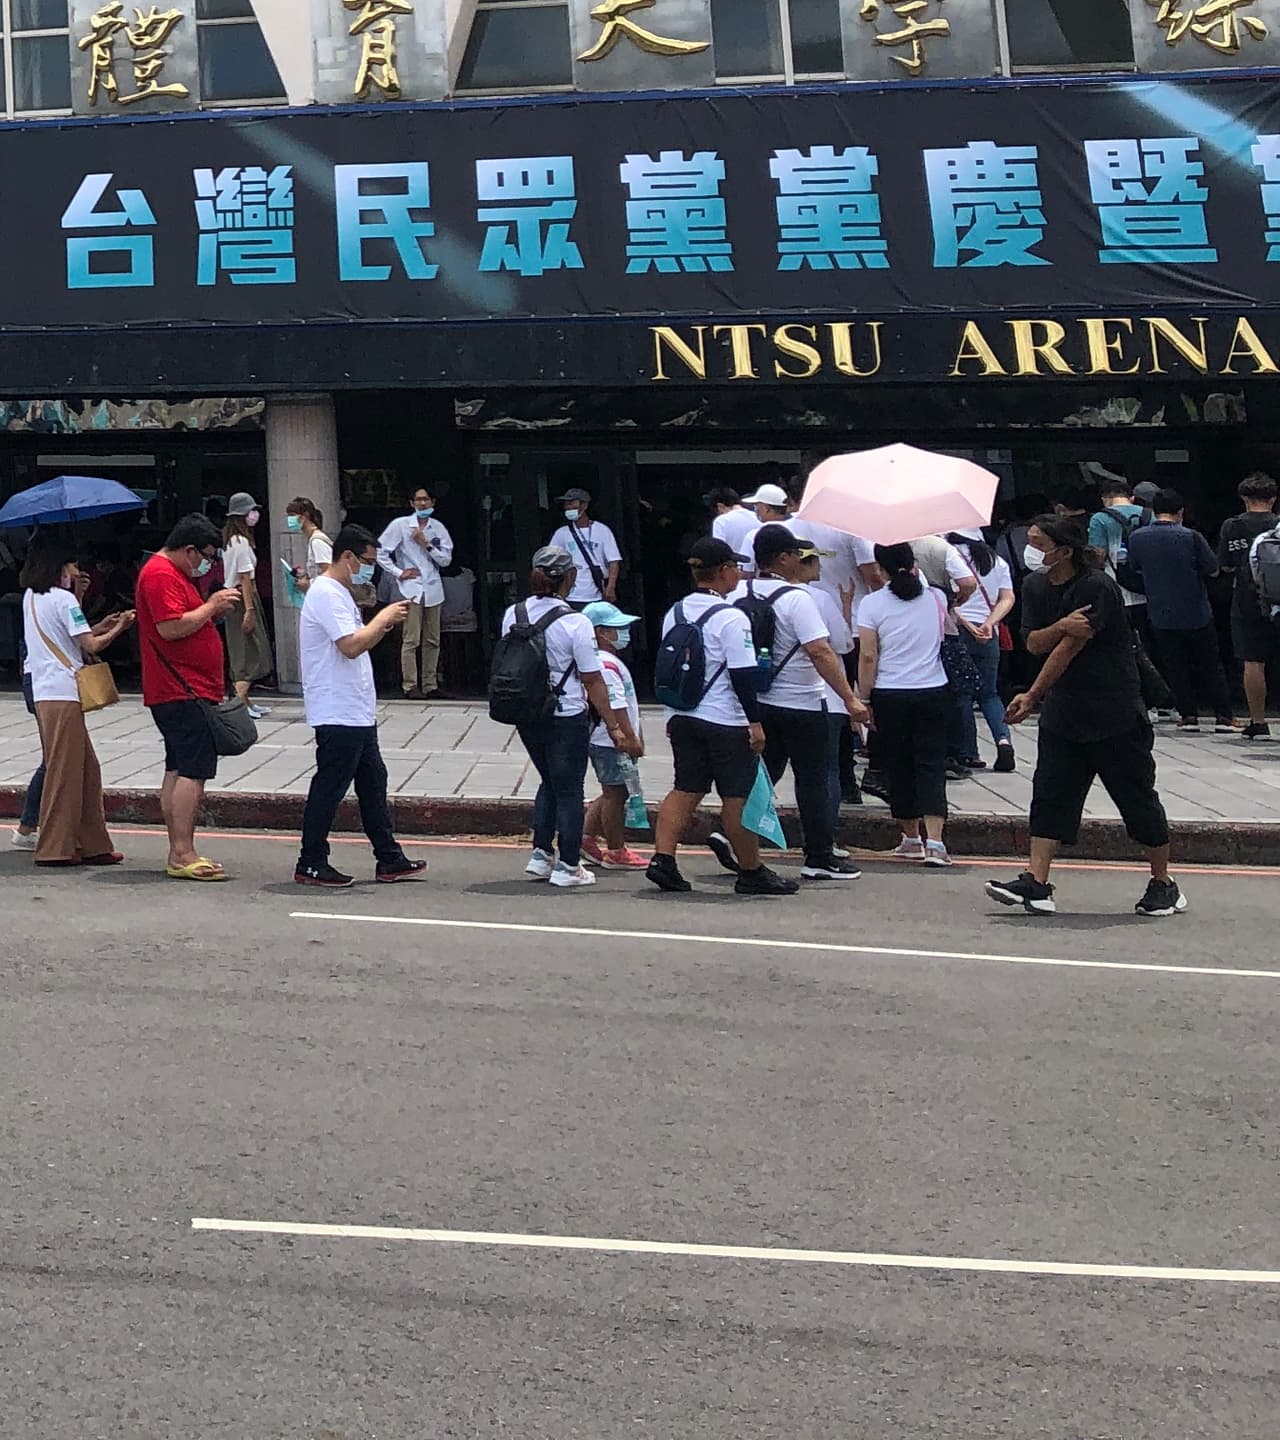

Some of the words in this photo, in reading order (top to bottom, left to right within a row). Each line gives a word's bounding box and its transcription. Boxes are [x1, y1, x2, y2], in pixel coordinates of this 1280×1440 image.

[60, 133, 1280, 290] 台灣民眾黨黨慶暨
[647, 321, 885, 381] NTSU
[948, 316, 1280, 379] ARENA
